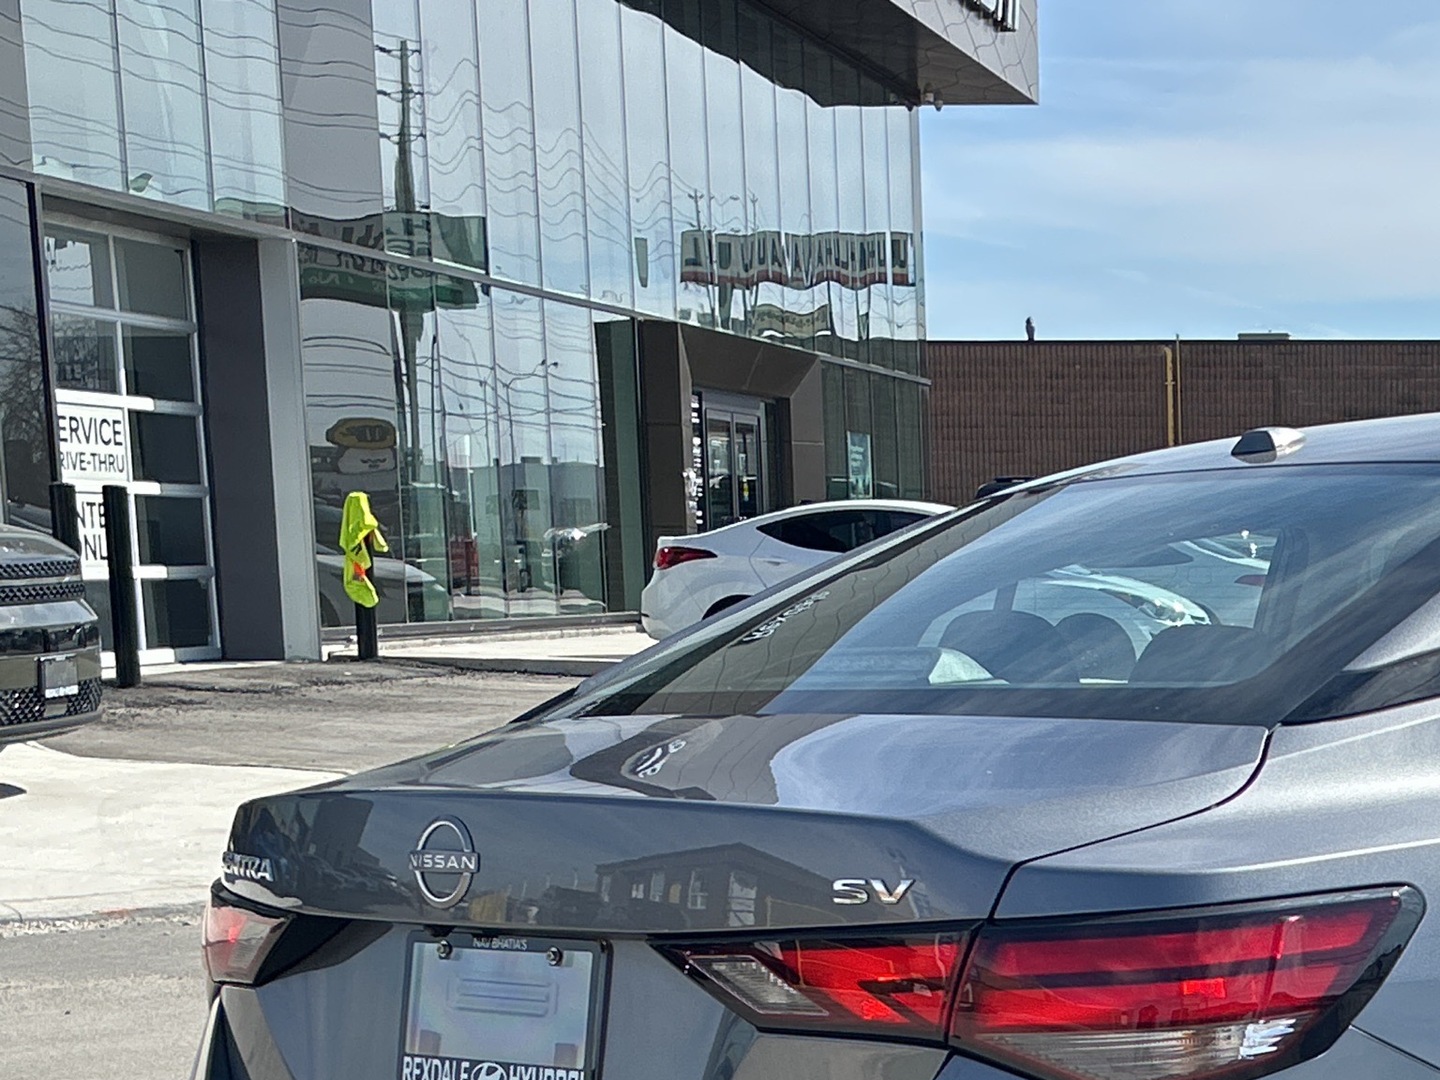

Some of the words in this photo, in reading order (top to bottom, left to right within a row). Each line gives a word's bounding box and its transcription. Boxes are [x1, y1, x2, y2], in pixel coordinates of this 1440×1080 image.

[59, 415, 123, 446] ERVICE
[60, 451, 125, 474] RIVE-THRU
[409, 853, 476, 870] NISSAN
[832, 879, 914, 905] SV
